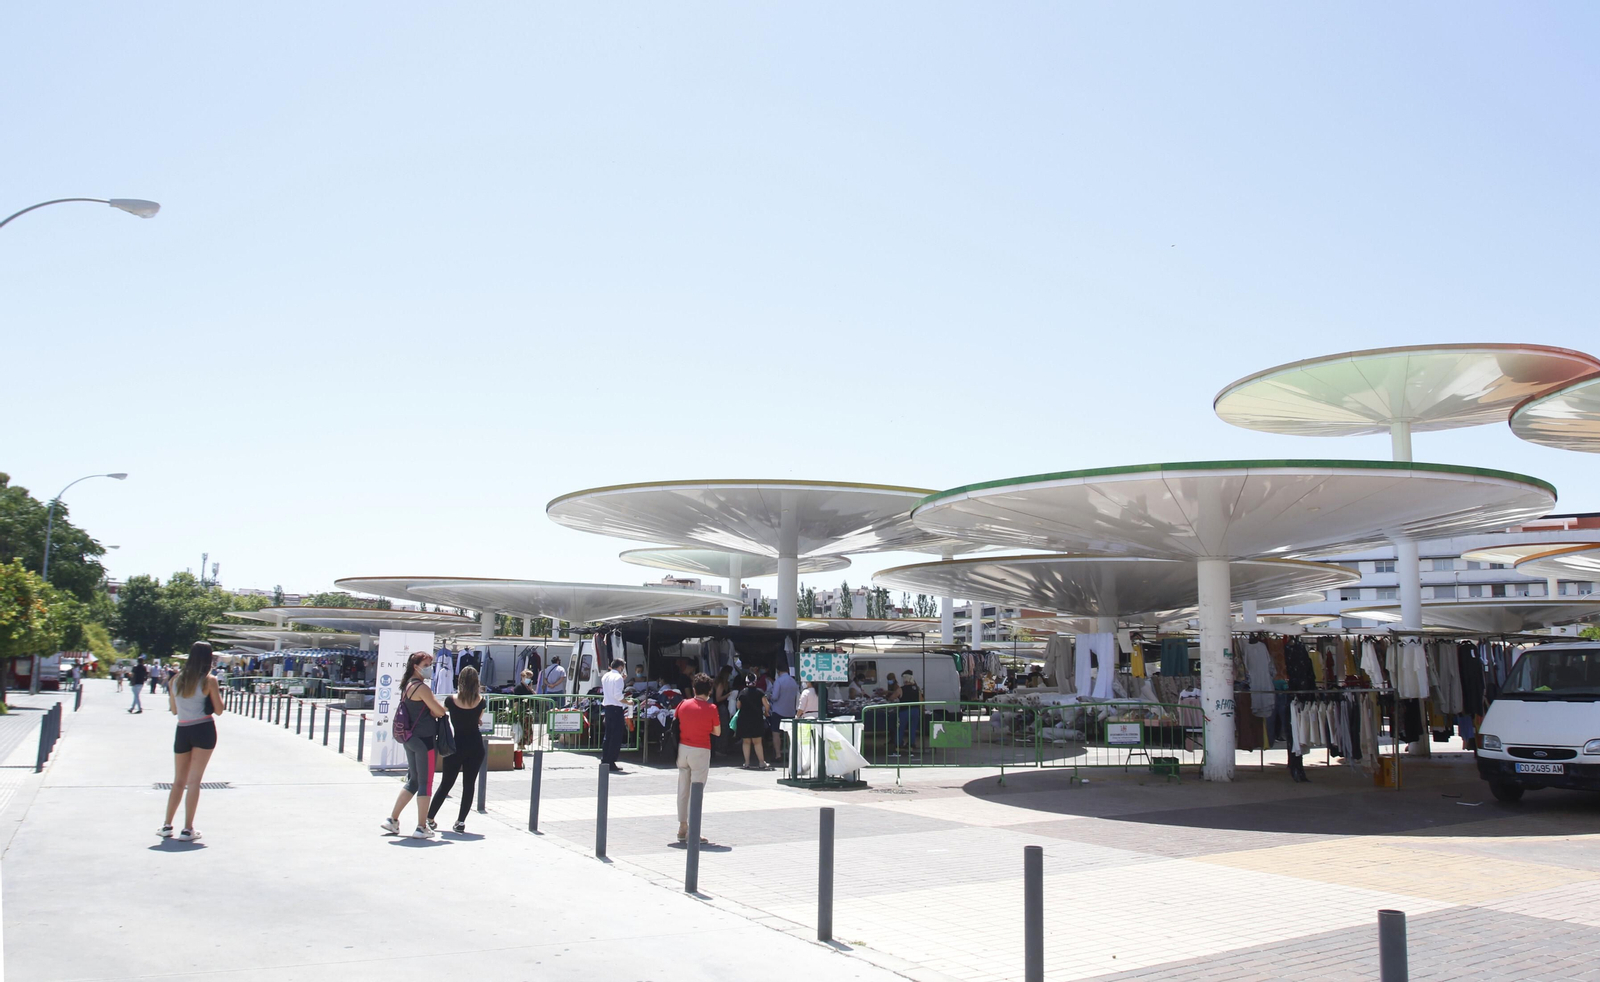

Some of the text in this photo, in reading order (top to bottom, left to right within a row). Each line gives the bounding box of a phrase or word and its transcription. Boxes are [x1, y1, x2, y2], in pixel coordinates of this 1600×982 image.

[1520, 764, 1563, 773] CO 2495 AM
